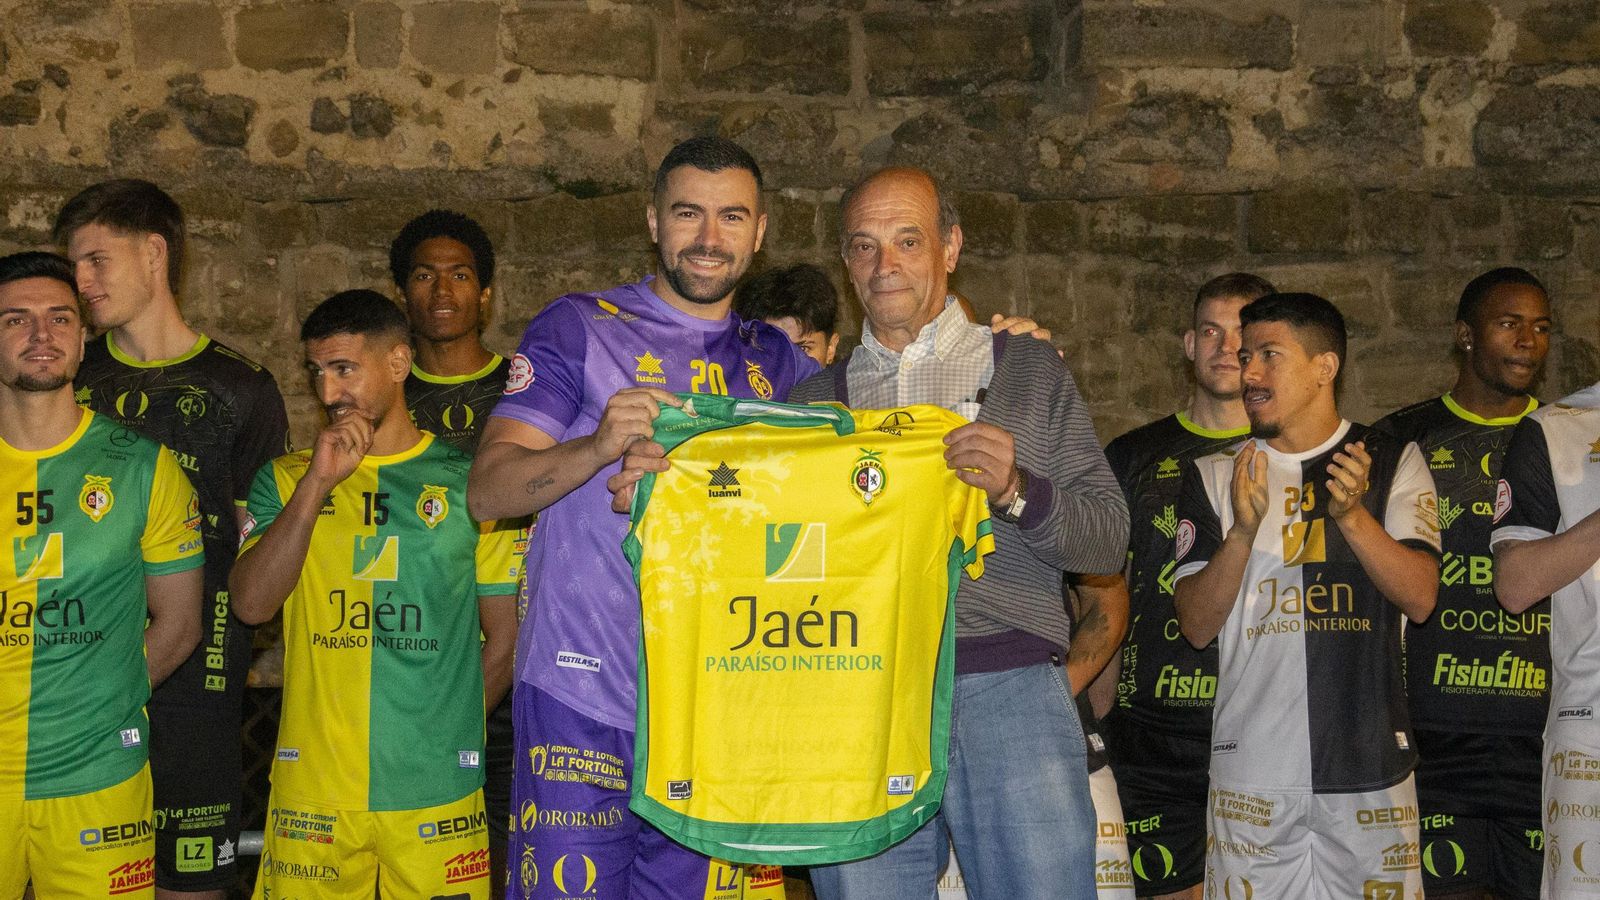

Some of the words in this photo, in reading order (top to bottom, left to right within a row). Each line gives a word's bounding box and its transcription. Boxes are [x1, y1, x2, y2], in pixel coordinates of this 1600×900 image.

[636, 374, 667, 385] luanvi
[690, 359, 728, 396] 20
[708, 488, 742, 498] luanvi
[1284, 481, 1315, 516] 23
[16, 489, 55, 526] 55
[362, 492, 390, 527] 15
[1258, 572, 1353, 621] Jaén
[329, 590, 422, 633] Jaén
[729, 594, 858, 651] Jaén
[1440, 608, 1551, 635] COCISUR
[34, 630, 105, 646] INTERIOR
[206, 591, 229, 670] Blanca
[1247, 617, 1300, 641] PARAÍSO
[1305, 617, 1372, 632] INTERIOR
[313, 632, 368, 650] PARAÍSO
[371, 635, 439, 651] INTERIOR
[705, 650, 787, 673] PARAÍSO
[792, 654, 883, 672] INTERIOR
[1433, 650, 1546, 690] FisioÉlite
[1440, 686, 1497, 696] FISIOTERAPIA
[1498, 688, 1542, 698] AVANZADA
[584, 749, 594, 758] DE
[1569, 759, 1580, 768] LA
[551, 755, 565, 767] LA
[568, 757, 624, 777] FORTUNA
[1227, 799, 1271, 817] FORTUNA
[1238, 793, 1246, 801] DE
[171, 808, 184, 818] LA
[187, 802, 231, 818] FORTUNA
[301, 811, 309, 819] DE
[280, 816, 288, 827] LA
[290, 818, 333, 833] FORTUNA
[183, 843, 206, 861] LZ
[715, 866, 740, 892] LZ
